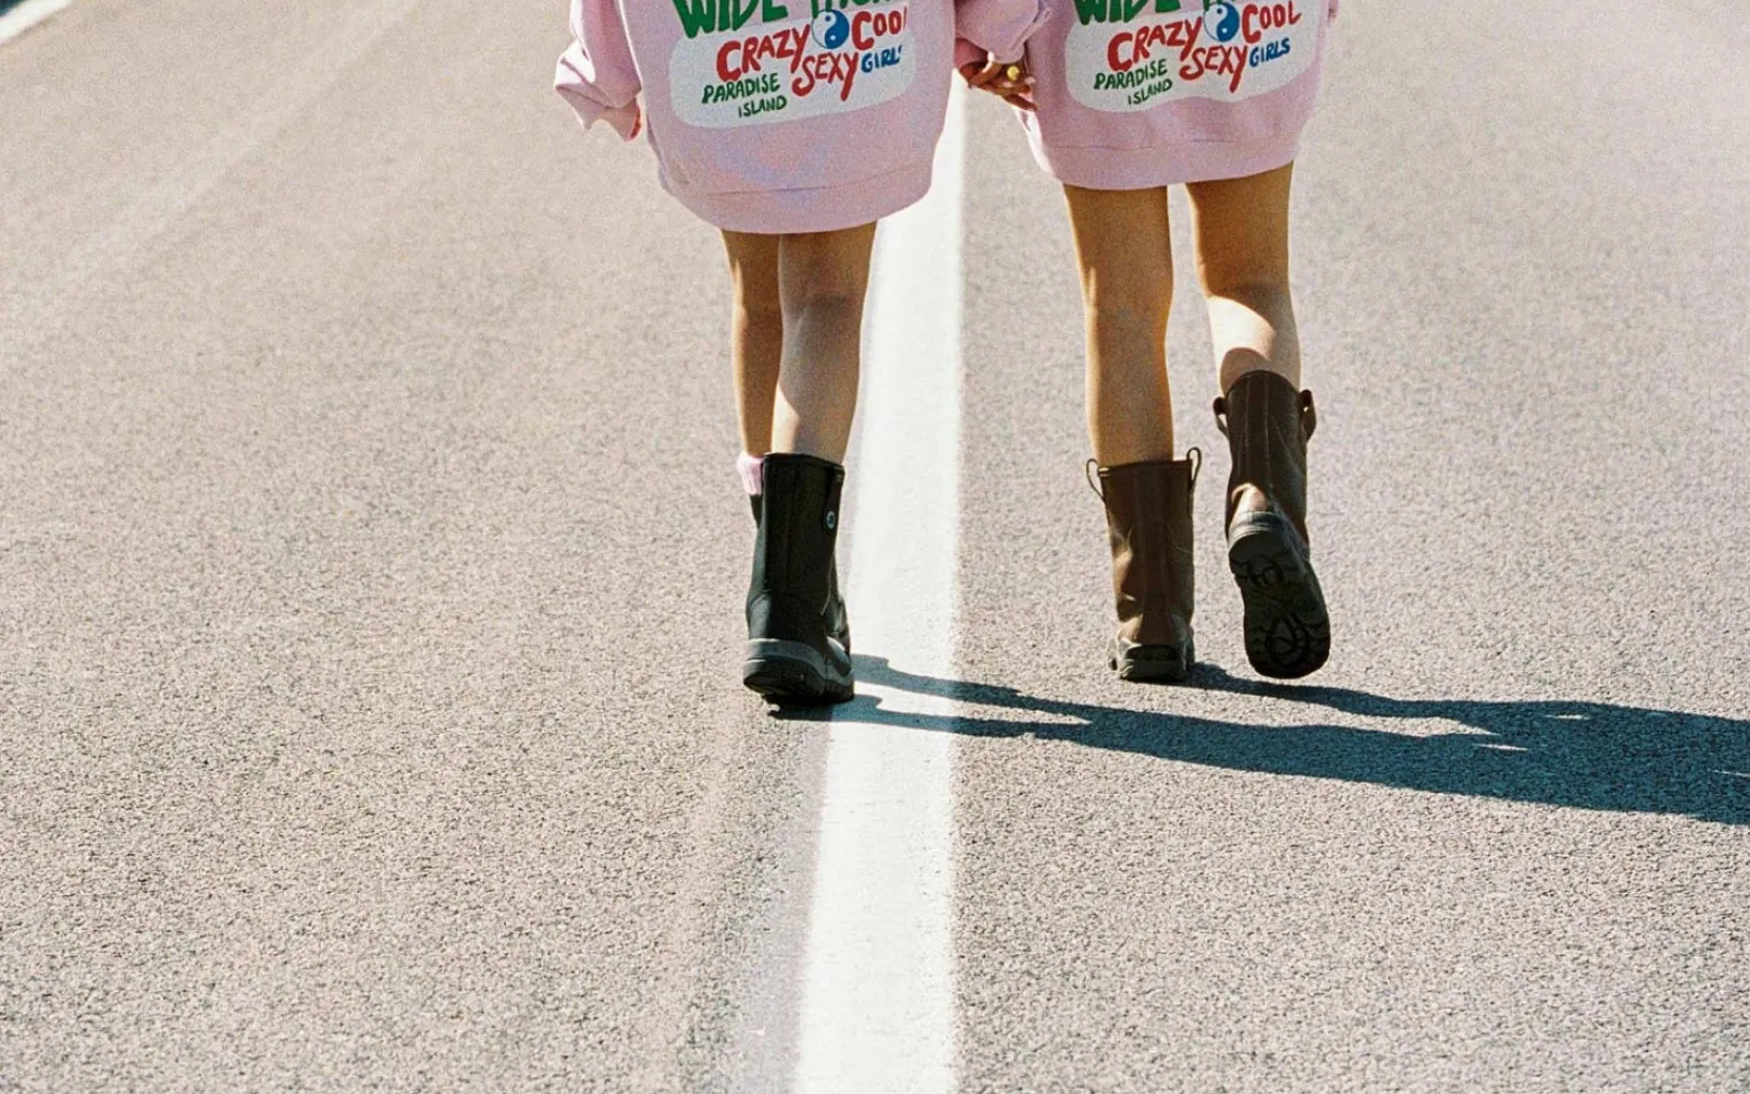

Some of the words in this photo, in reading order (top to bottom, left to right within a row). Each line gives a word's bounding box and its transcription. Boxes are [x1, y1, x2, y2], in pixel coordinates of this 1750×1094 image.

[716, 24, 811, 82] CRAZY
[1107, 15, 1203, 73] CRAZY
[1241, 0, 1302, 44] COOL
[1249, 37, 1291, 68] GIRLS
[791, 52, 860, 102] SEXY
[1093, 58, 1168, 90] PARADISE
[1179, 43, 1249, 94] SEXY
[701, 72, 781, 105] PARADISE
[1127, 78, 1173, 106] ISLAND
[737, 94, 788, 119] ISLAND
